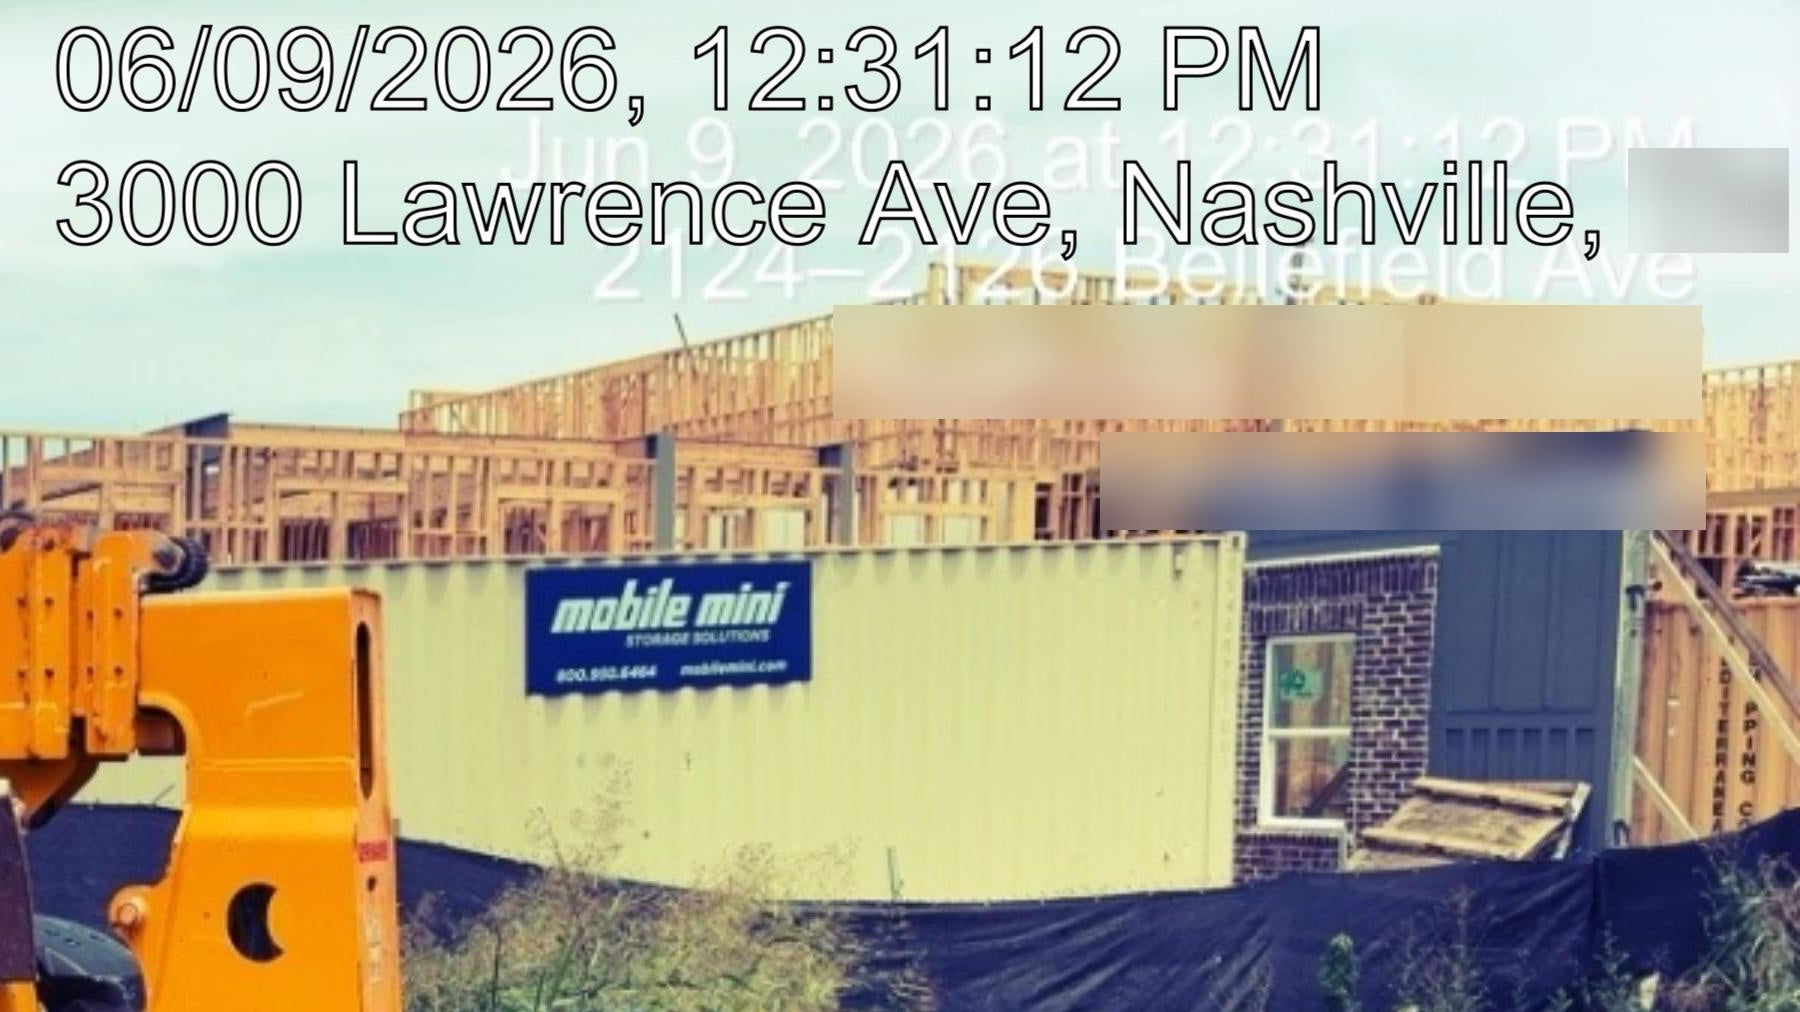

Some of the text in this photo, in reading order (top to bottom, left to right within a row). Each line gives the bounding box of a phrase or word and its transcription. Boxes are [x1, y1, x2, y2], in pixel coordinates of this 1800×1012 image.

[551, 578, 792, 634] mobile mini
[693, 629, 771, 645] SOLUTIONS
